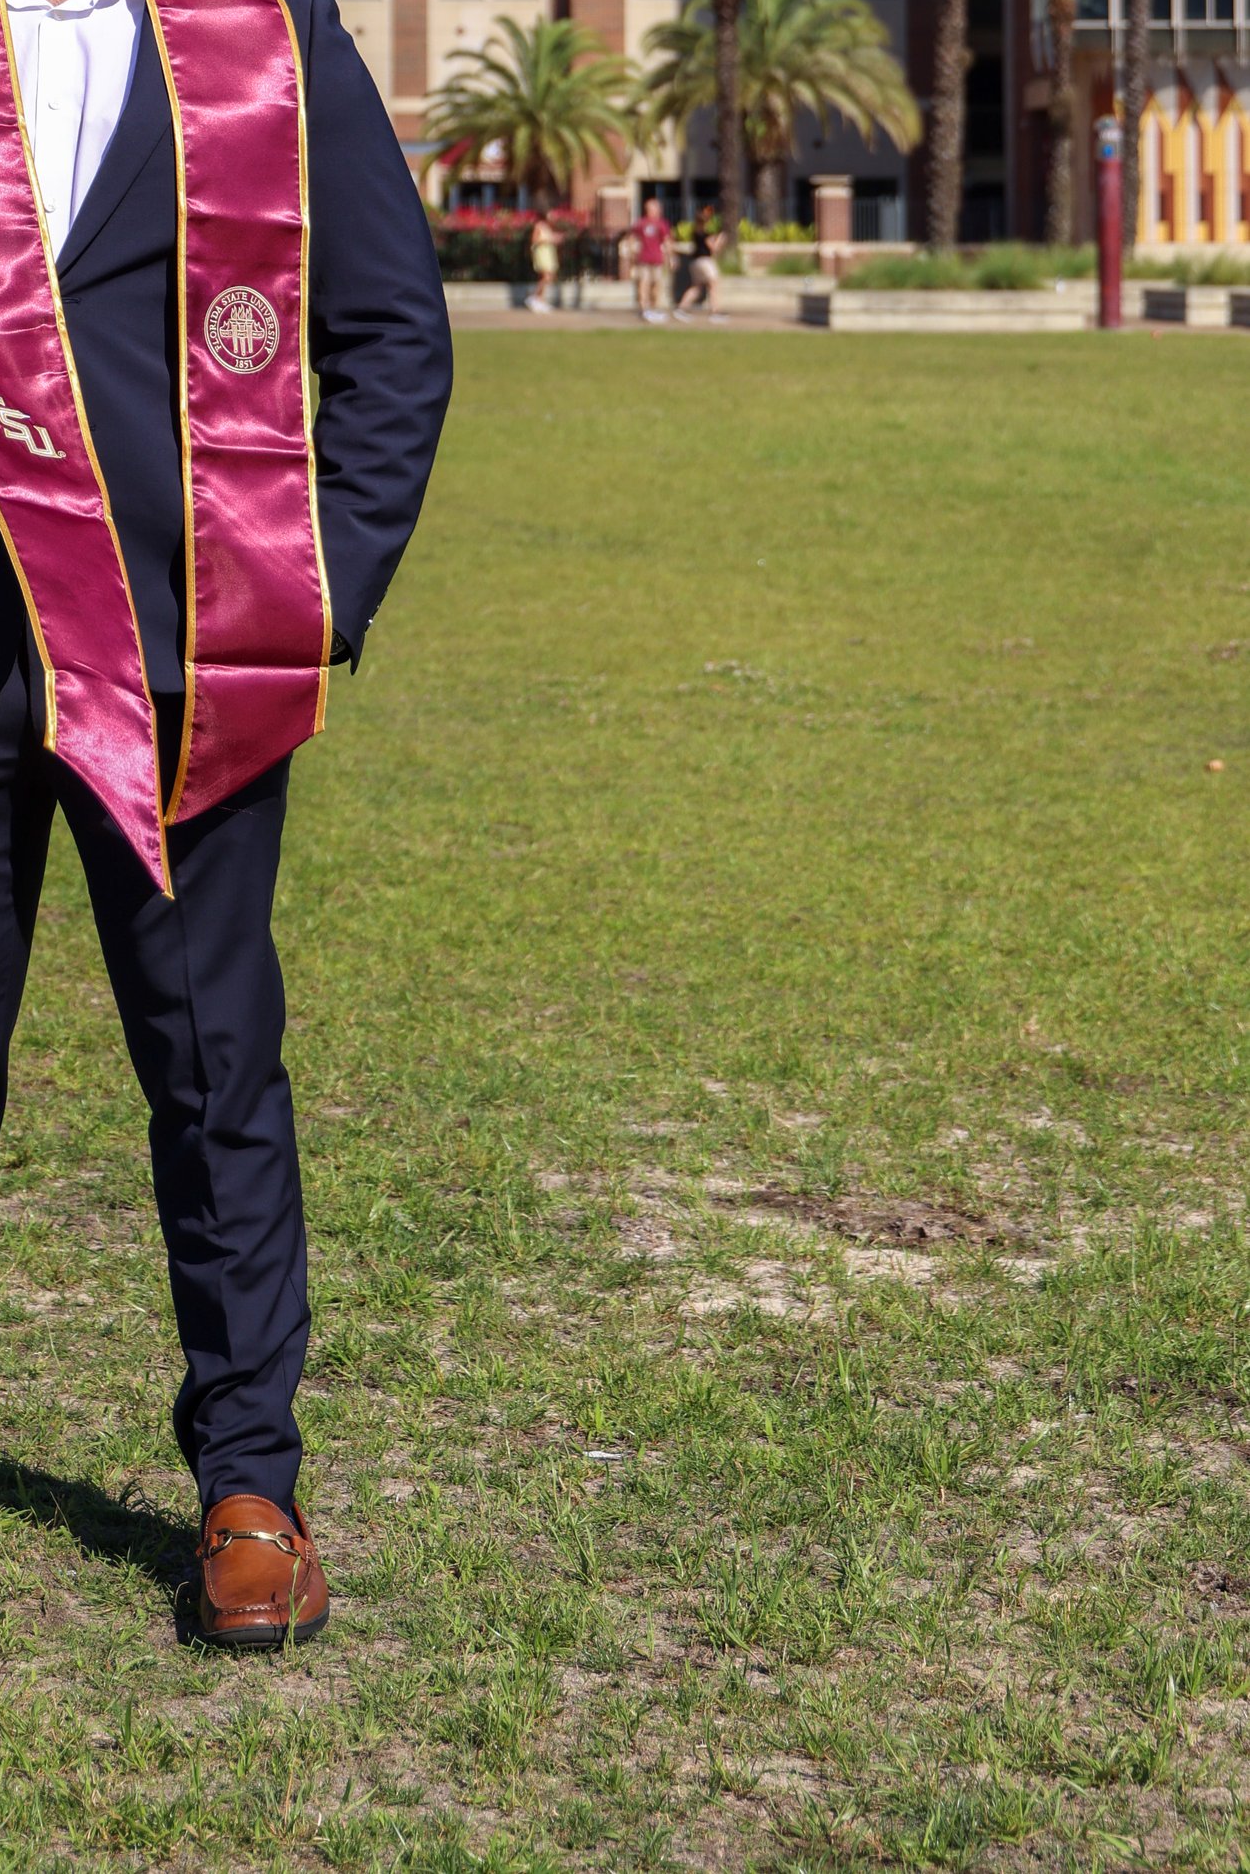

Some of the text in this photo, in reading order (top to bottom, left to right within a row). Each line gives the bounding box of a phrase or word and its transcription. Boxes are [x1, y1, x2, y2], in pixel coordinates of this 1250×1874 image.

[209, 292, 275, 354] FLORIDA STATE UNIVERSITY
[235, 359, 253, 369] 1851
